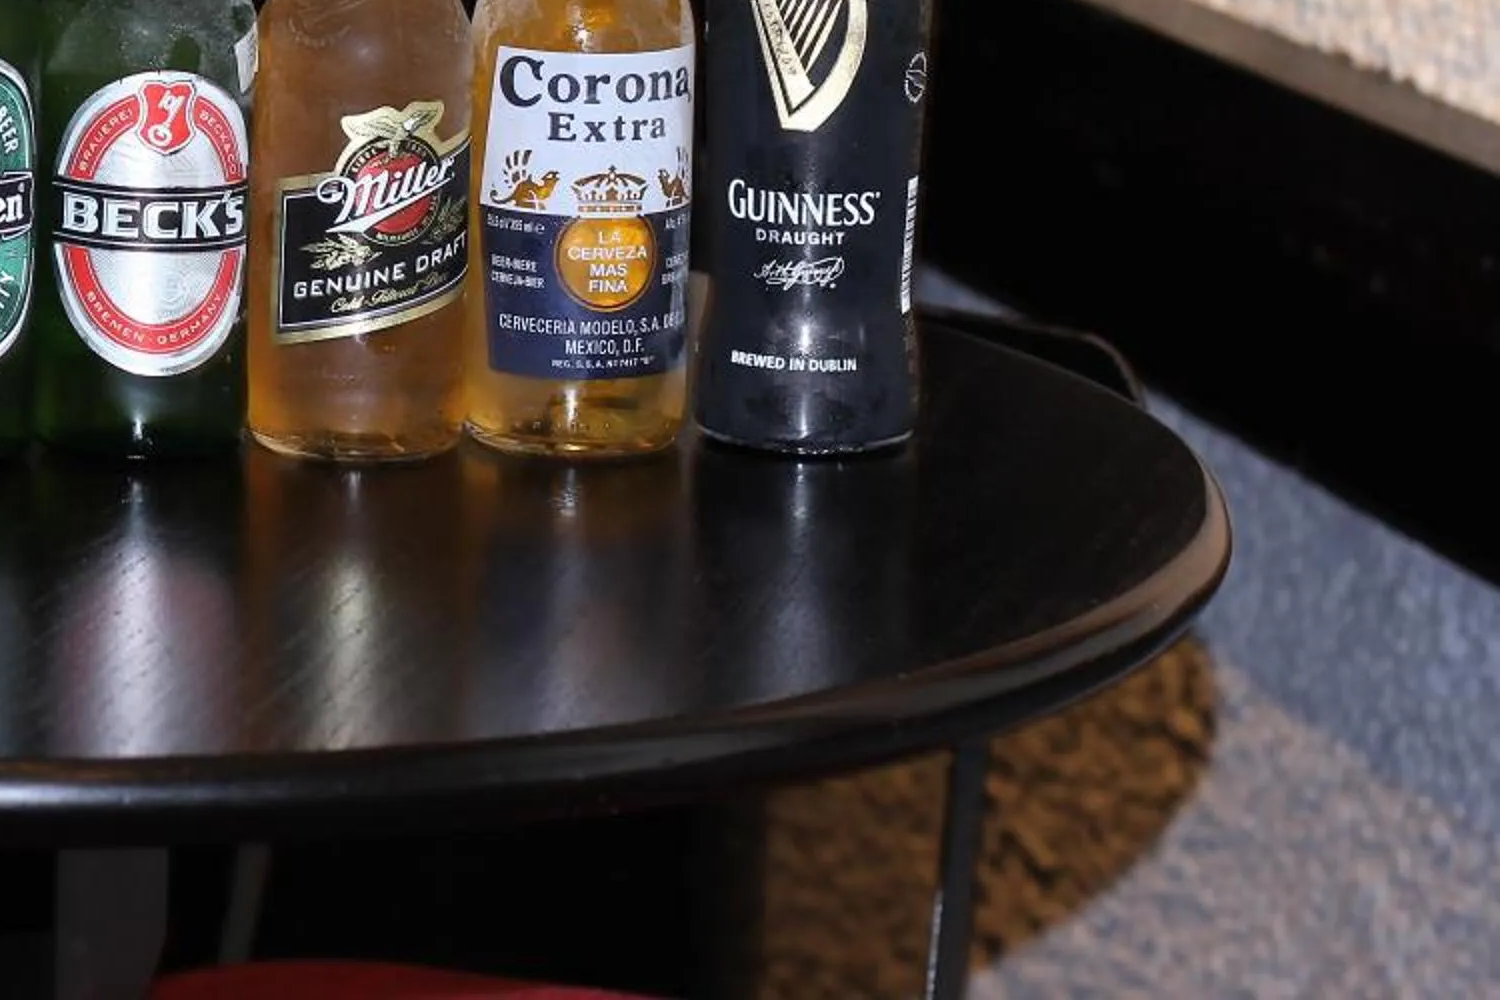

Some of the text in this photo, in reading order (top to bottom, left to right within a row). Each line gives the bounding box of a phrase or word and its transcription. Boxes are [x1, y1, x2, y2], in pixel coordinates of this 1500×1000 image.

[499, 55, 691, 109] Corona
[77, 107, 133, 172] BRAUEREI
[547, 111, 666, 143] Extra
[317, 157, 453, 224] Miller
[727, 178, 876, 227] GUINNESS
[567, 245, 648, 261] CERVEZA
[598, 231, 622, 245] LA
[755, 228, 846, 246] DRAUGHT
[293, 229, 468, 299] GENUINE DRAFT
[589, 263, 628, 279] MAS
[588, 279, 629, 294] FINA
[86, 290, 222, 345] BREMEN GERMANY
[731, 349, 858, 373] BREWED IN DUBLIN
